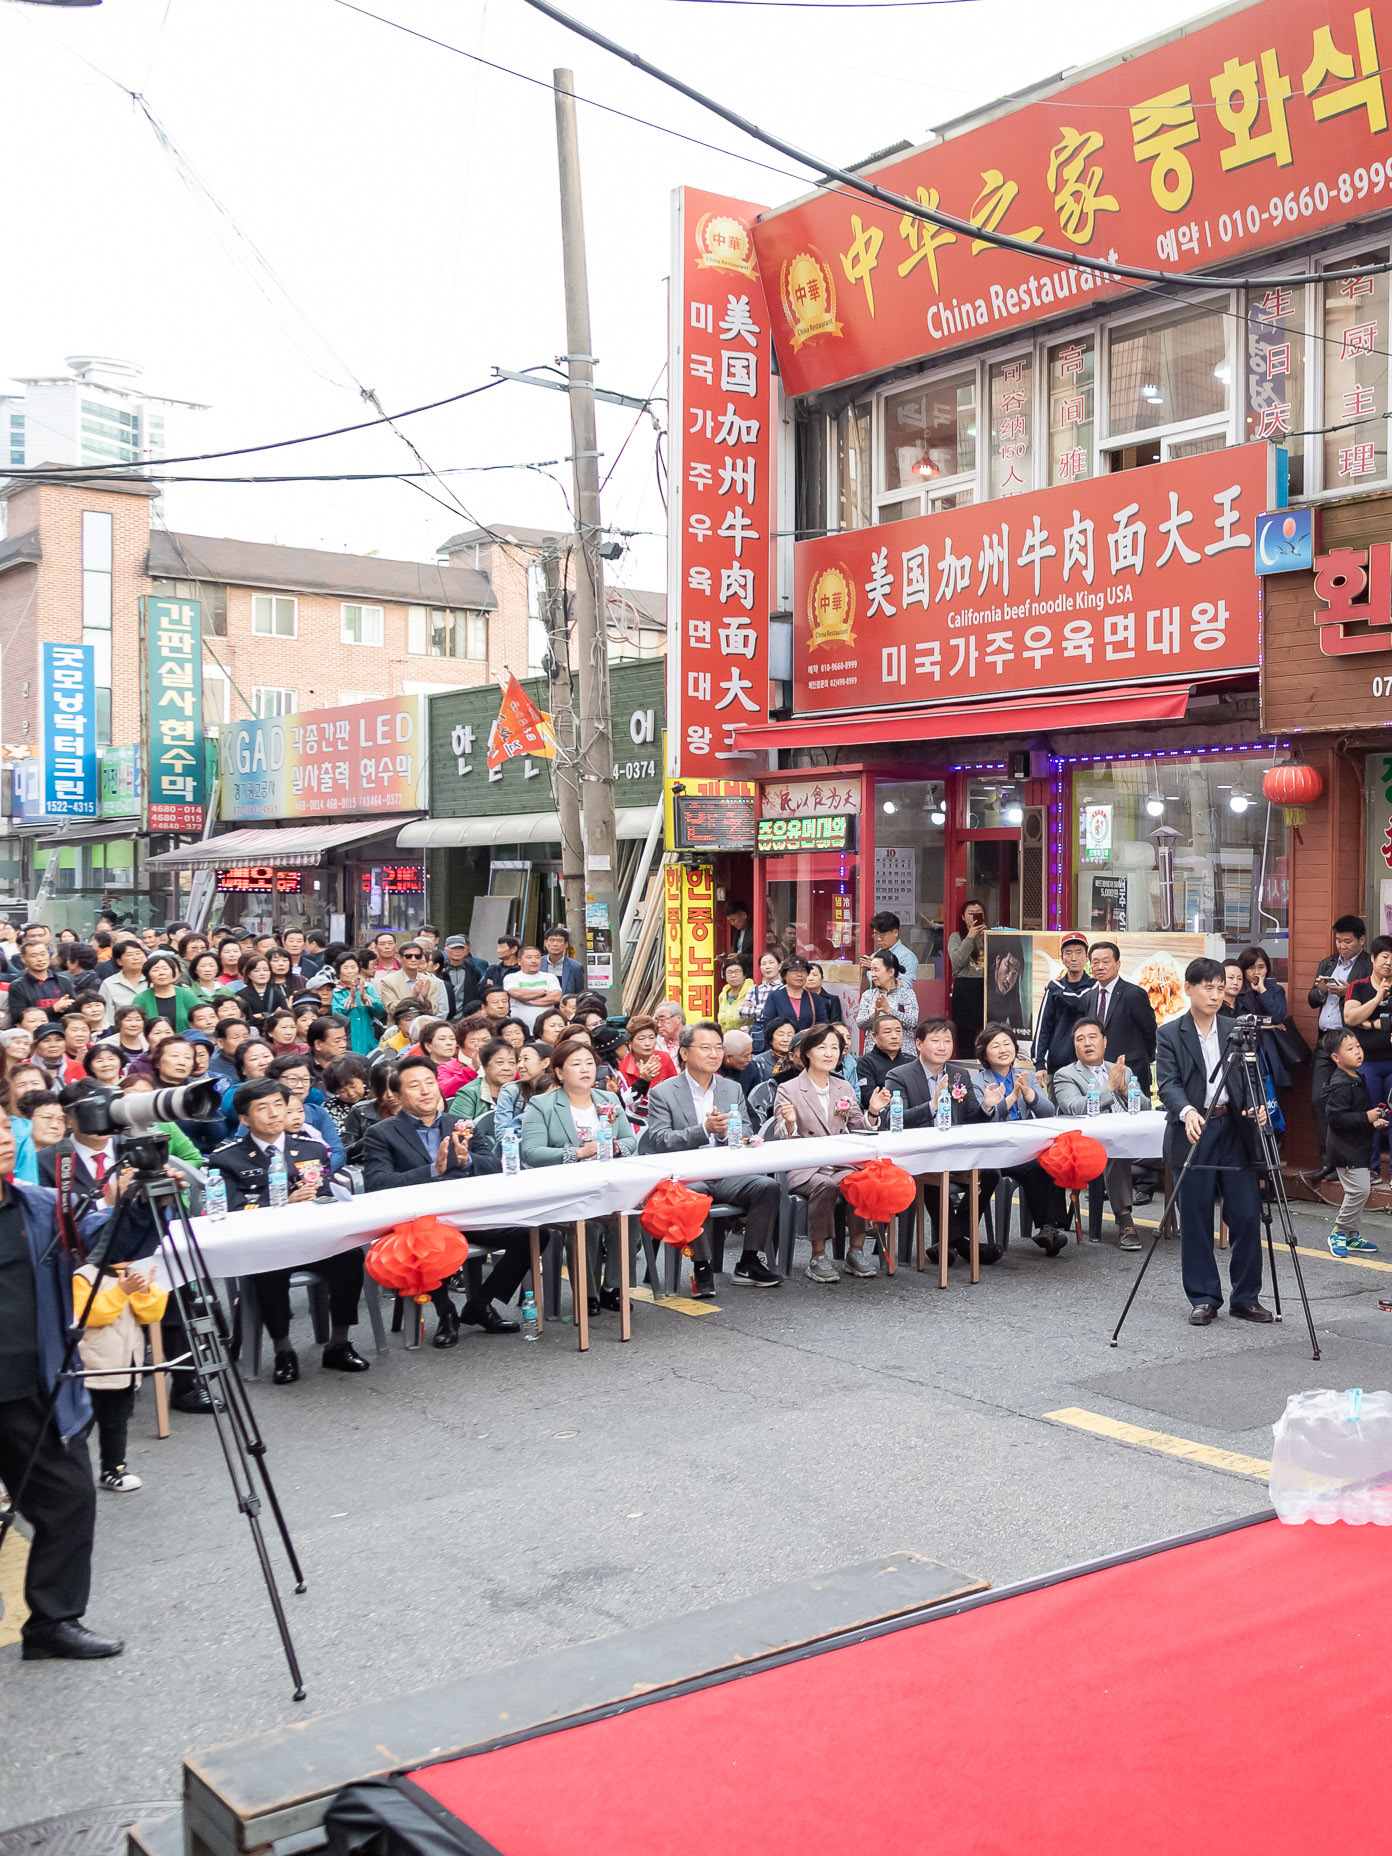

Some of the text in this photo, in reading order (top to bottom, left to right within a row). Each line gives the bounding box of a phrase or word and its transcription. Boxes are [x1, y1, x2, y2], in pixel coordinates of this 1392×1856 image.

[712, 233, 742, 251] 中華
[1155, 232, 1200, 264] 예약
[795, 278, 821, 306] 中華
[925, 246, 1123, 340] China Restaurant
[1257, 286, 1294, 439] 生日庆
[1000, 359, 1027, 498] 可容纳150人
[687, 301, 715, 755] 미국가주우육면대왕
[867, 485, 1252, 621] 美国加州牛肉面大王
[820, 591, 842, 613] 中華
[948, 585, 1134, 629] California beef noodle King USA
[881, 602, 1230, 685] 미국가주우육면대왕
[52, 646, 86, 801] 굿모닝닥터크린
[157, 603, 197, 802] 간판실사현수막
[221, 725, 285, 776] KGAD
[290, 712, 414, 755] 각종간판 LED
[290, 754, 414, 796] 실사출력 현수막
[46, 801, 94, 813] 1522-4315
[151, 805, 202, 814] 4680-014
[151, 814, 202, 822] 4680-015
